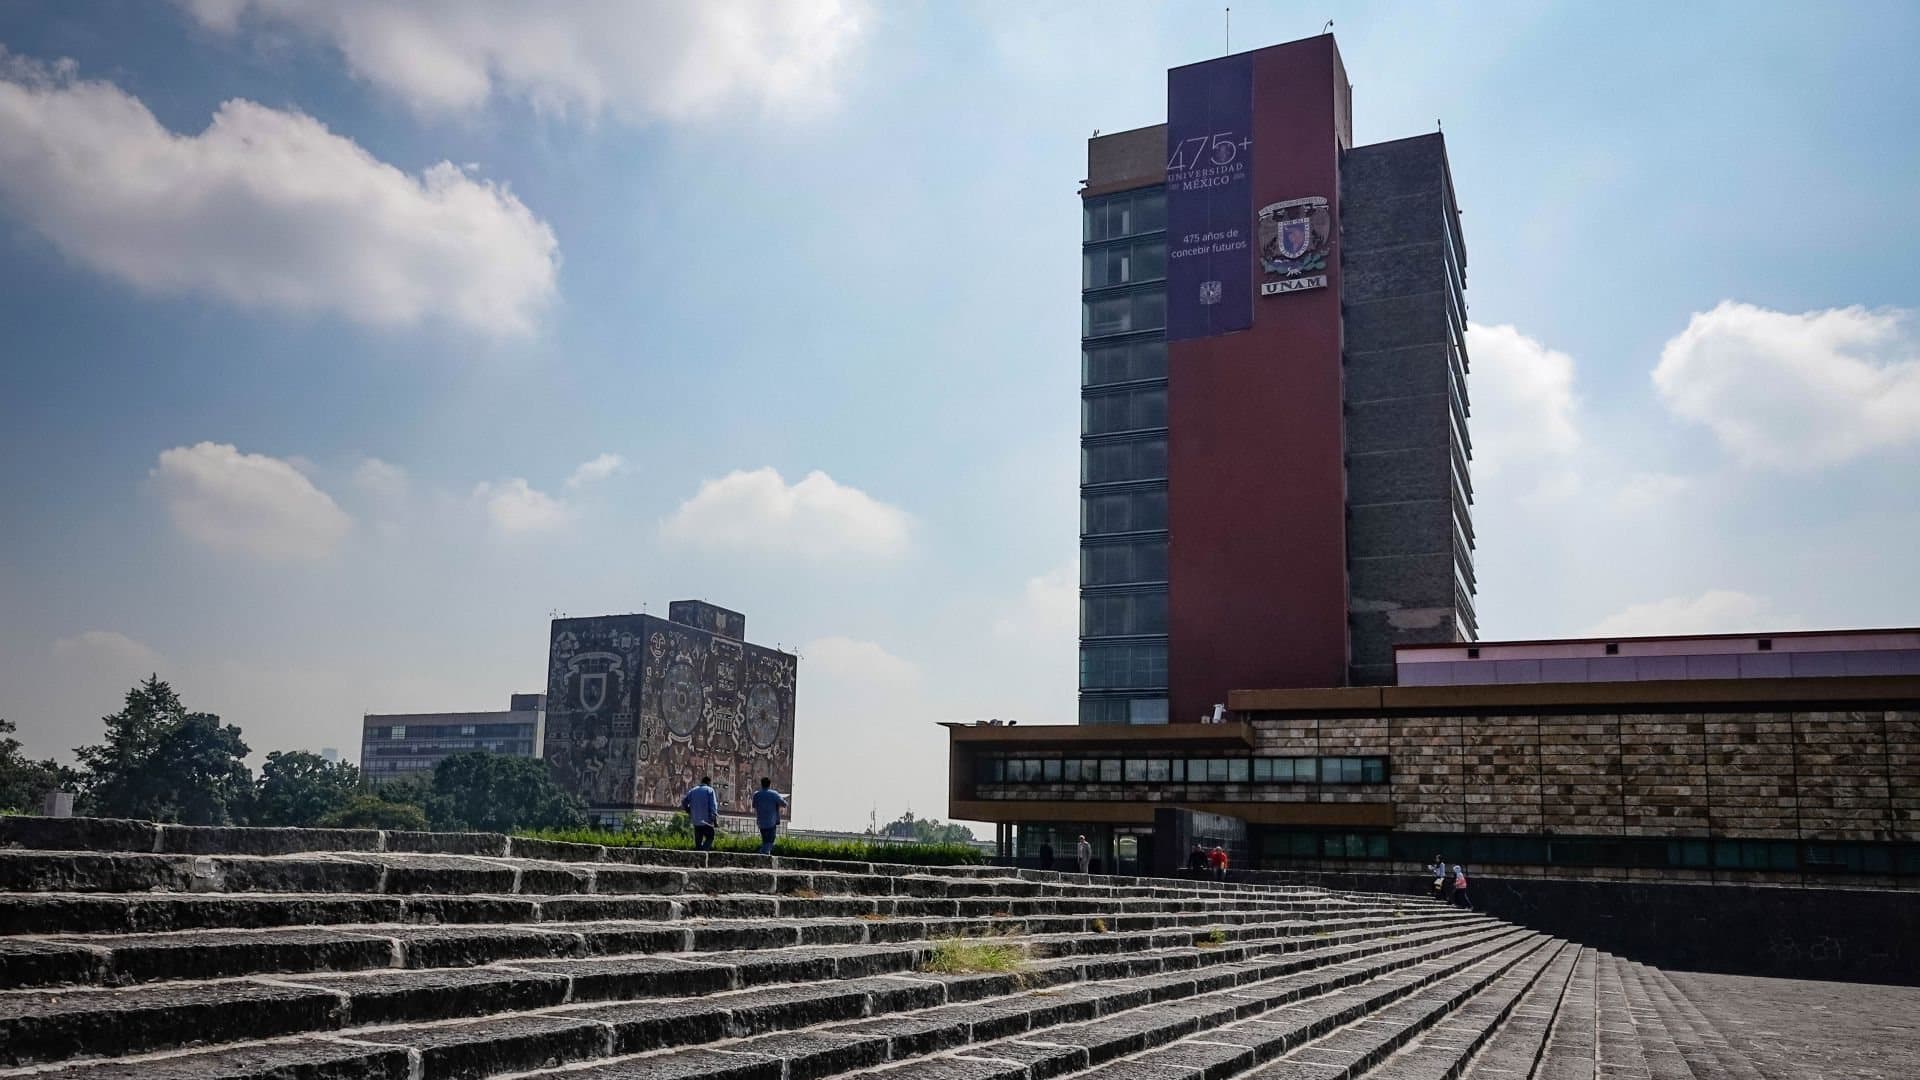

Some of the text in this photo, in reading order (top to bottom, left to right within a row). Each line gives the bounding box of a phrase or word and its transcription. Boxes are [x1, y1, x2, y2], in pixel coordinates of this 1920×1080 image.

[1168, 162, 1244, 181] UNIVERSIDAD
[1183, 175, 1230, 191] MÉXICO
[1183, 228, 1239, 244] 475 años de
[1171, 240, 1248, 258] concebir futuros
[1264, 277, 1322, 293] UNAM
